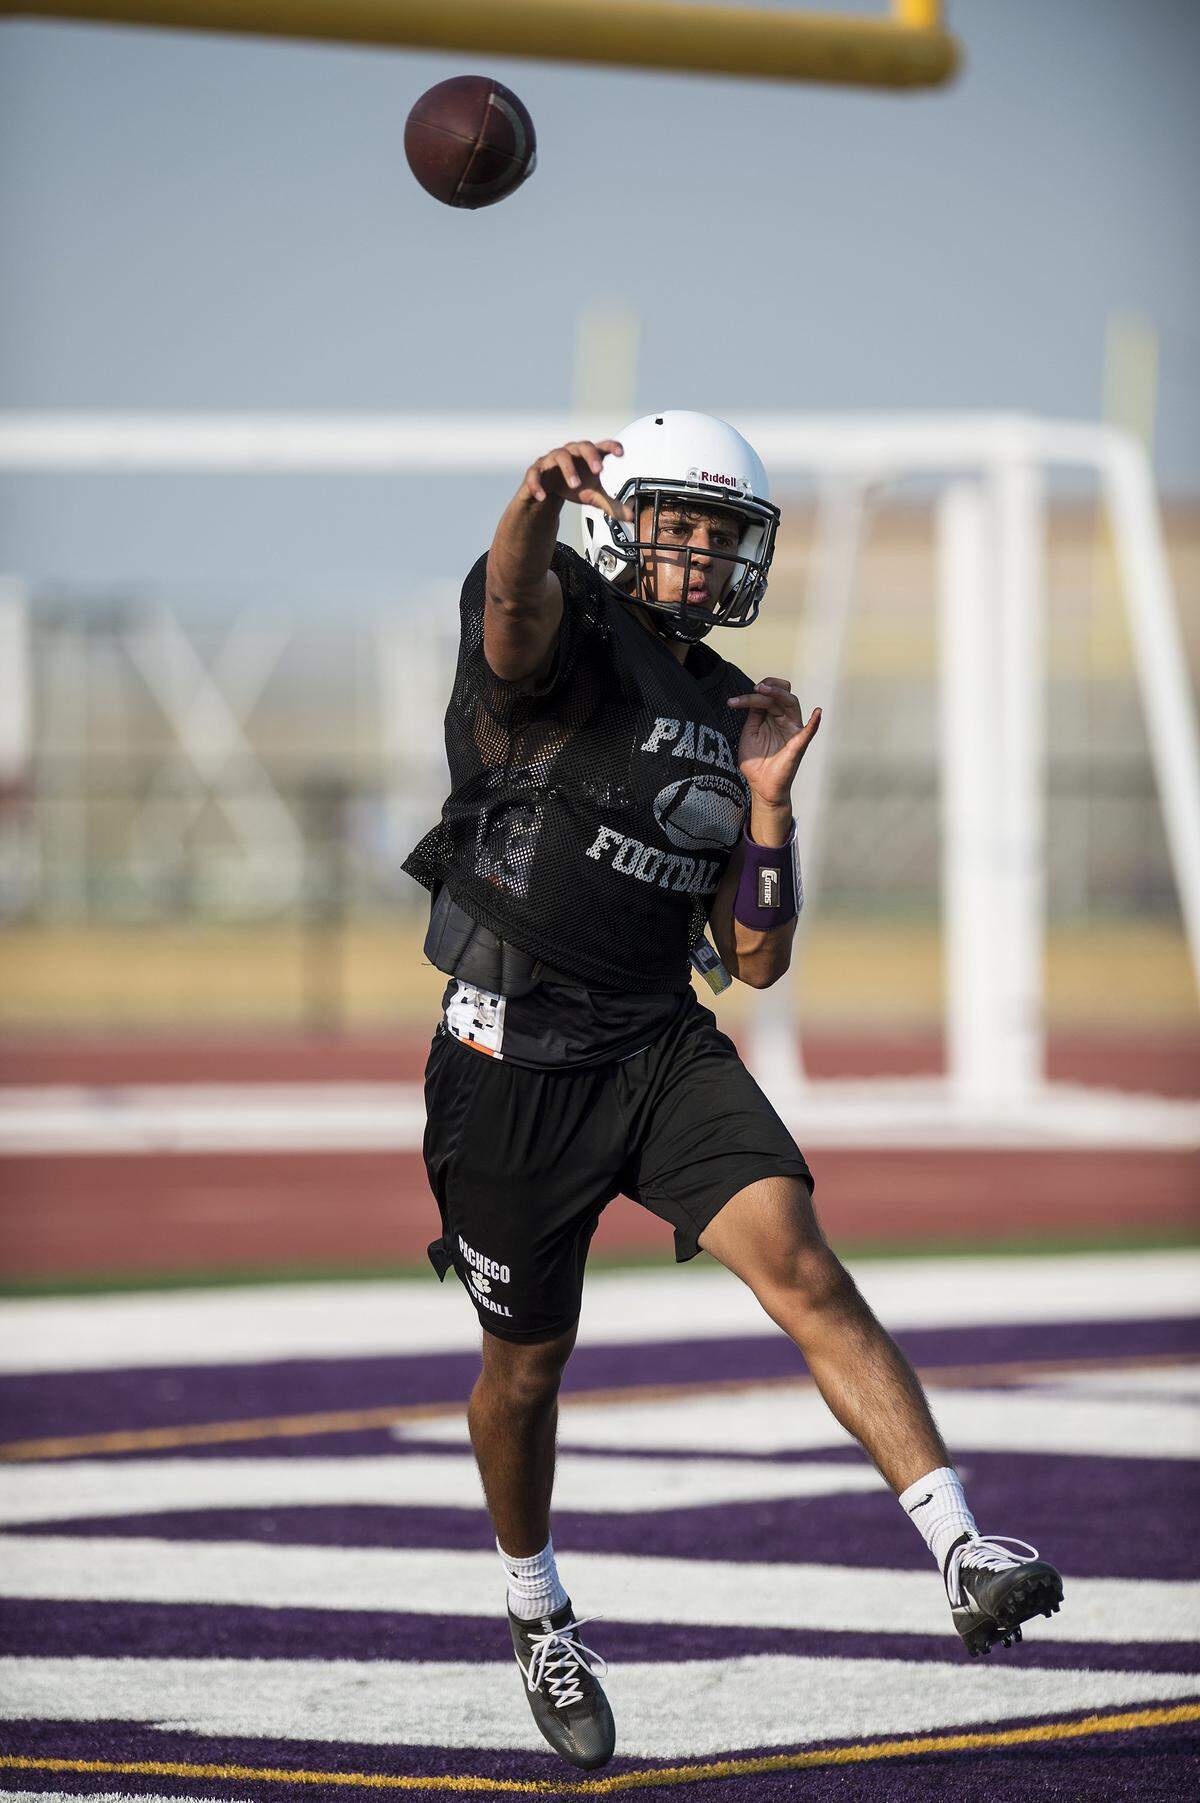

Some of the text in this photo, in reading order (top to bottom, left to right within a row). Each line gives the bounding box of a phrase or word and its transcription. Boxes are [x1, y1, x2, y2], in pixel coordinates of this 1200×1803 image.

[701, 471, 737, 488] Riddell
[640, 717, 738, 774] PACH
[585, 825, 721, 894] FOOTBAL
[458, 1234, 511, 1284] PACHECO
[465, 1273, 513, 1318] OTBALL
